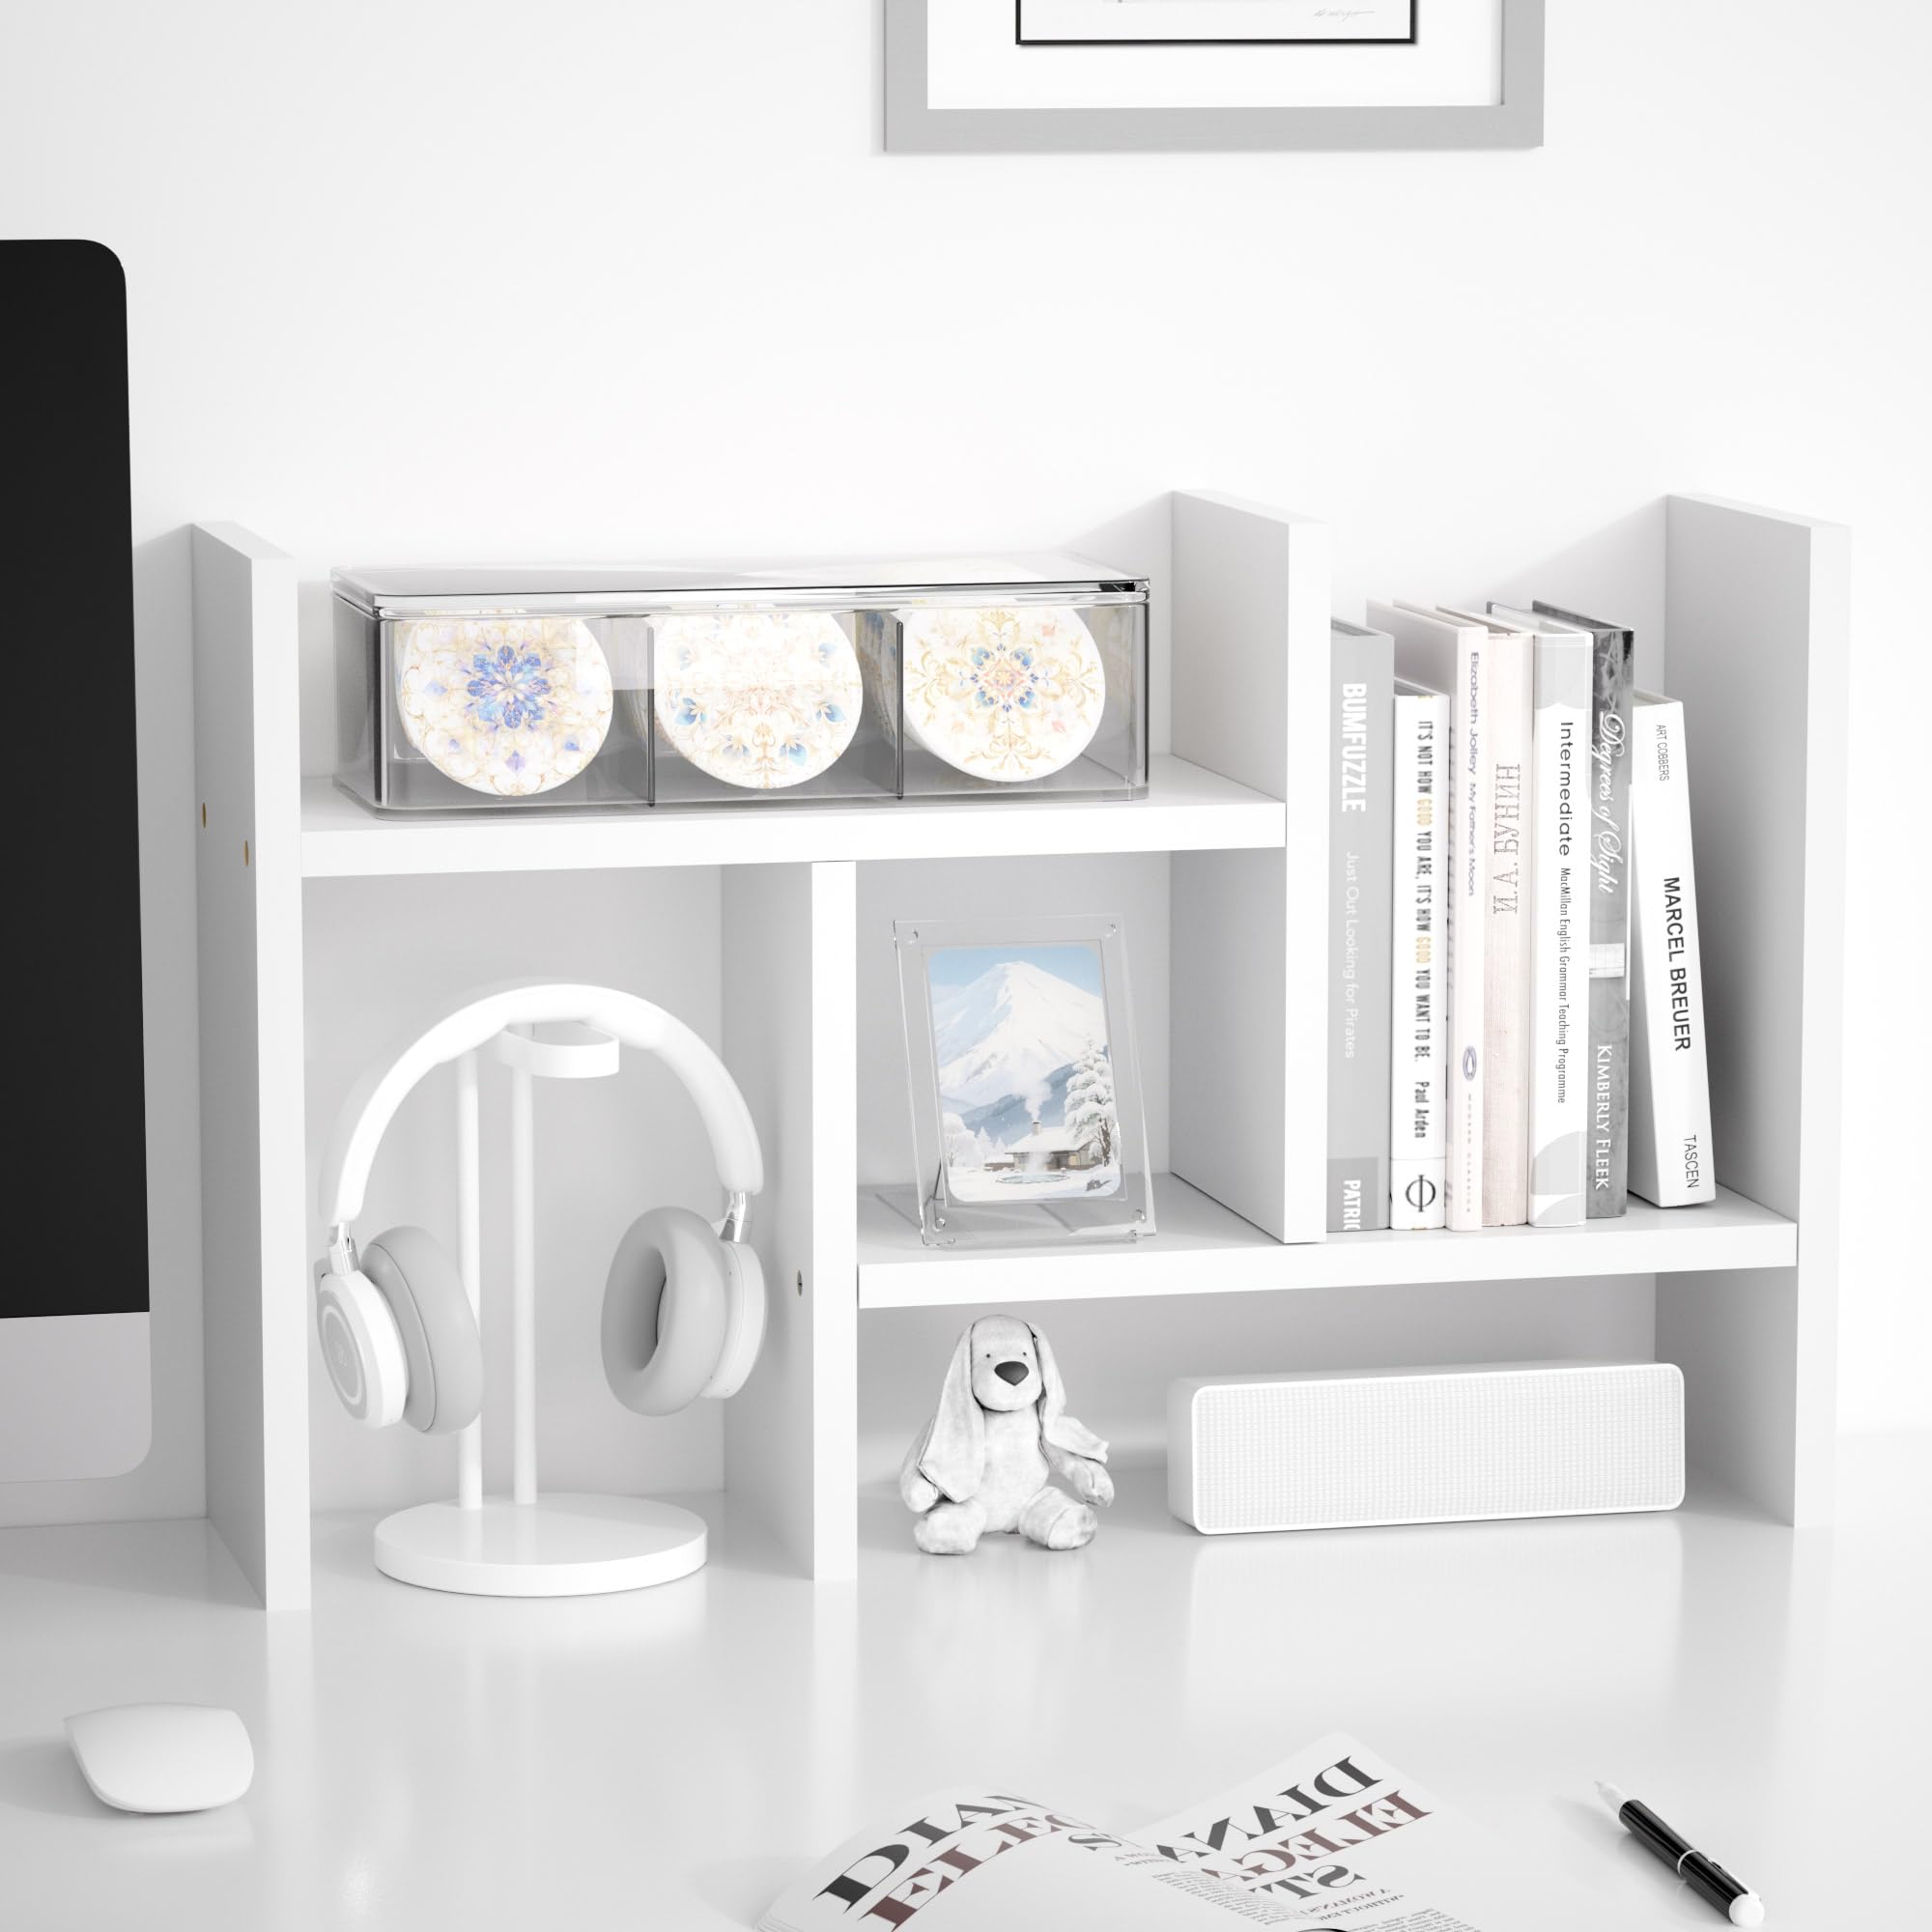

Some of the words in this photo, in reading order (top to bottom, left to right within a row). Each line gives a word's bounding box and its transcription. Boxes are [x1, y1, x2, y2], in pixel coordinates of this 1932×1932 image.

[1470, 652, 1479, 724] Elizabeth
[1417, 721, 1434, 740] IT'S
[1656, 724, 1667, 740] ART
[1342, 683, 1367, 811] BUMFUZZLE
[1417, 746, 1434, 766] NOT
[1468, 728, 1478, 774] Jolley
[1592, 712, 1625, 802] Degrees
[1657, 742, 1670, 781] COBBERS
[1416, 771, 1433, 794] HOW
[1468, 783, 1476, 802] My
[1559, 722, 1574, 856] Intermediate
[1416, 799, 1433, 826] GOOD
[1493, 763, 1520, 856] БУНИН
[1594, 805, 1620, 833] of
[1416, 831, 1433, 851] YOU
[1346, 851, 1360, 882] Just
[1414, 856, 1432, 879] ARE,
[1591, 831, 1624, 894] Sight
[1346, 886, 1360, 915] Out
[1416, 885, 1432, 904] IT'S
[1560, 867, 1572, 916] MacMillan
[1416, 909, 1432, 931] HOW
[1663, 876, 1685, 962] MARCEL
[1343, 919, 1360, 979] Looking
[1415, 937, 1432, 964] GOOD
[1557, 919, 1572, 952] English
[1345, 982, 1360, 1004] for
[1415, 969, 1431, 989] YOU
[1558, 955, 1571, 1002] Grammar
[1415, 994, 1431, 1023] WANT
[1556, 1004, 1570, 1045] Teaching
[1669, 967, 1691, 1052] BREUER
[1345, 1008, 1359, 1059] Pirates
[1415, 1028, 1431, 1040] TO
[1415, 1081, 1431, 1103] Paul
[1556, 1048, 1569, 1104] Programme
[1597, 1045, 1613, 1133] KIMBERLY
[1414, 1109, 1430, 1139] Arden
[1596, 1139, 1610, 1191] FLEEK
[1684, 1133, 1699, 1188] TASCEN
